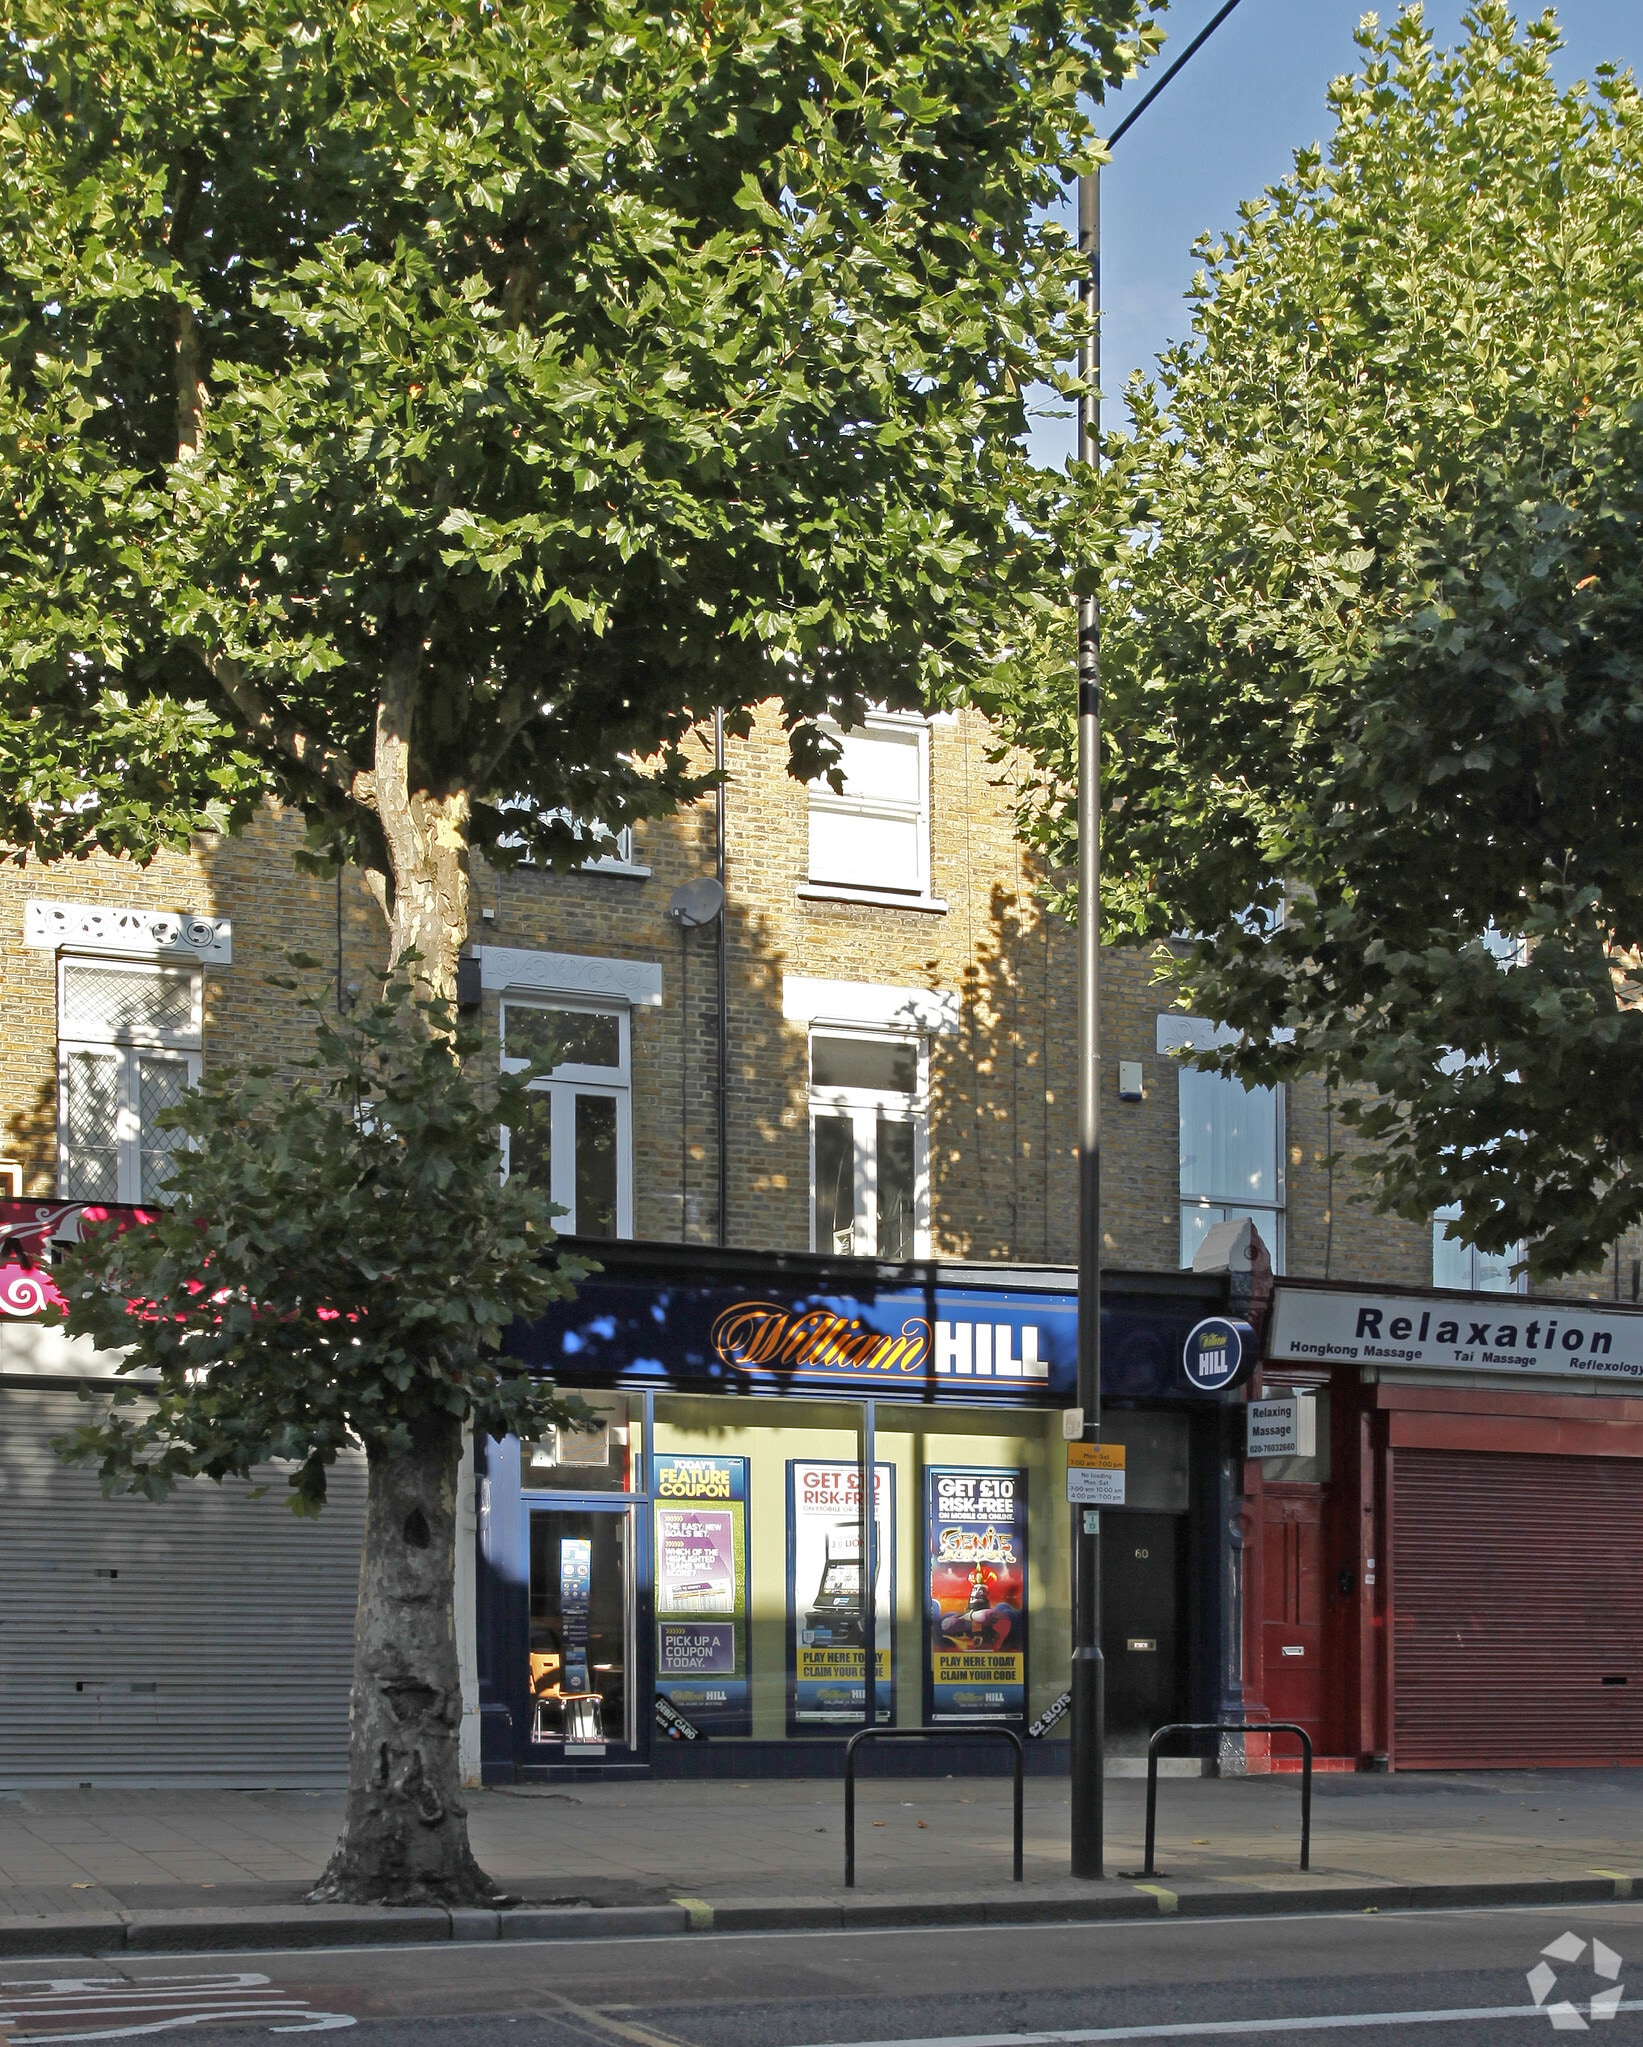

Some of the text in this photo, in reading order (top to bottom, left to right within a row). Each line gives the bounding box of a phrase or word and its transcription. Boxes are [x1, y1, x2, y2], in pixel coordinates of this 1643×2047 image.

[1356, 1307, 1613, 1354] Relaxation
[712, 1301, 1048, 1377] William HILL
[1290, 1341, 1423, 1361] Hongkong Massage
[1199, 1350, 1228, 1376] HILL
[1454, 1351, 1537, 1368] Tai Massage
[1569, 1357, 1643, 1376] Reflexology
[1253, 1406, 1291, 1418] Relaxing
[1252, 1426, 1291, 1437] Massage
[673, 1459, 716, 1470] TODAY'S
[659, 1468, 730, 1485] FEATURE
[803, 1472, 842, 1489] GET
[659, 1483, 730, 1498] COUPON
[937, 1478, 976, 1497] GET
[938, 1497, 1014, 1513] RISK-FREE
[950, 1512, 976, 1520] MOBILE
[664, 1522, 680, 1531] THE
[705, 1523, 722, 1531] NEW
[665, 1530, 692, 1538] GOALS
[665, 1548, 719, 1557] WHICH OF THE
[1135, 1548, 1149, 1559] 60
[665, 1555, 715, 1563] HIGHLIGHTED
[665, 1562, 712, 1571] TEAMS WILL
[665, 1569, 697, 1577] SCORE?
[665, 1636, 721, 1647] PICK UP A
[666, 1647, 713, 1657] COUPON
[803, 1652, 826, 1663] PLAY
[827, 1653, 851, 1663] HERE
[665, 1657, 706, 1668] TODAY.
[940, 1656, 1016, 1667] PLAY HERE TODAY
[803, 1666, 832, 1677] CLAIM
[833, 1666, 858, 1677] YOUR
[940, 1670, 1017, 1681] CLAIM YOUR CODE
[706, 1690, 727, 1701] HILL
[985, 1692, 1005, 1702] HILL
[1028, 1692, 1072, 1737] £2 SLOTS
[655, 1701, 676, 1721] DEBIT
[674, 1718, 696, 1740] CARD
[655, 1715, 669, 1728] VISA
